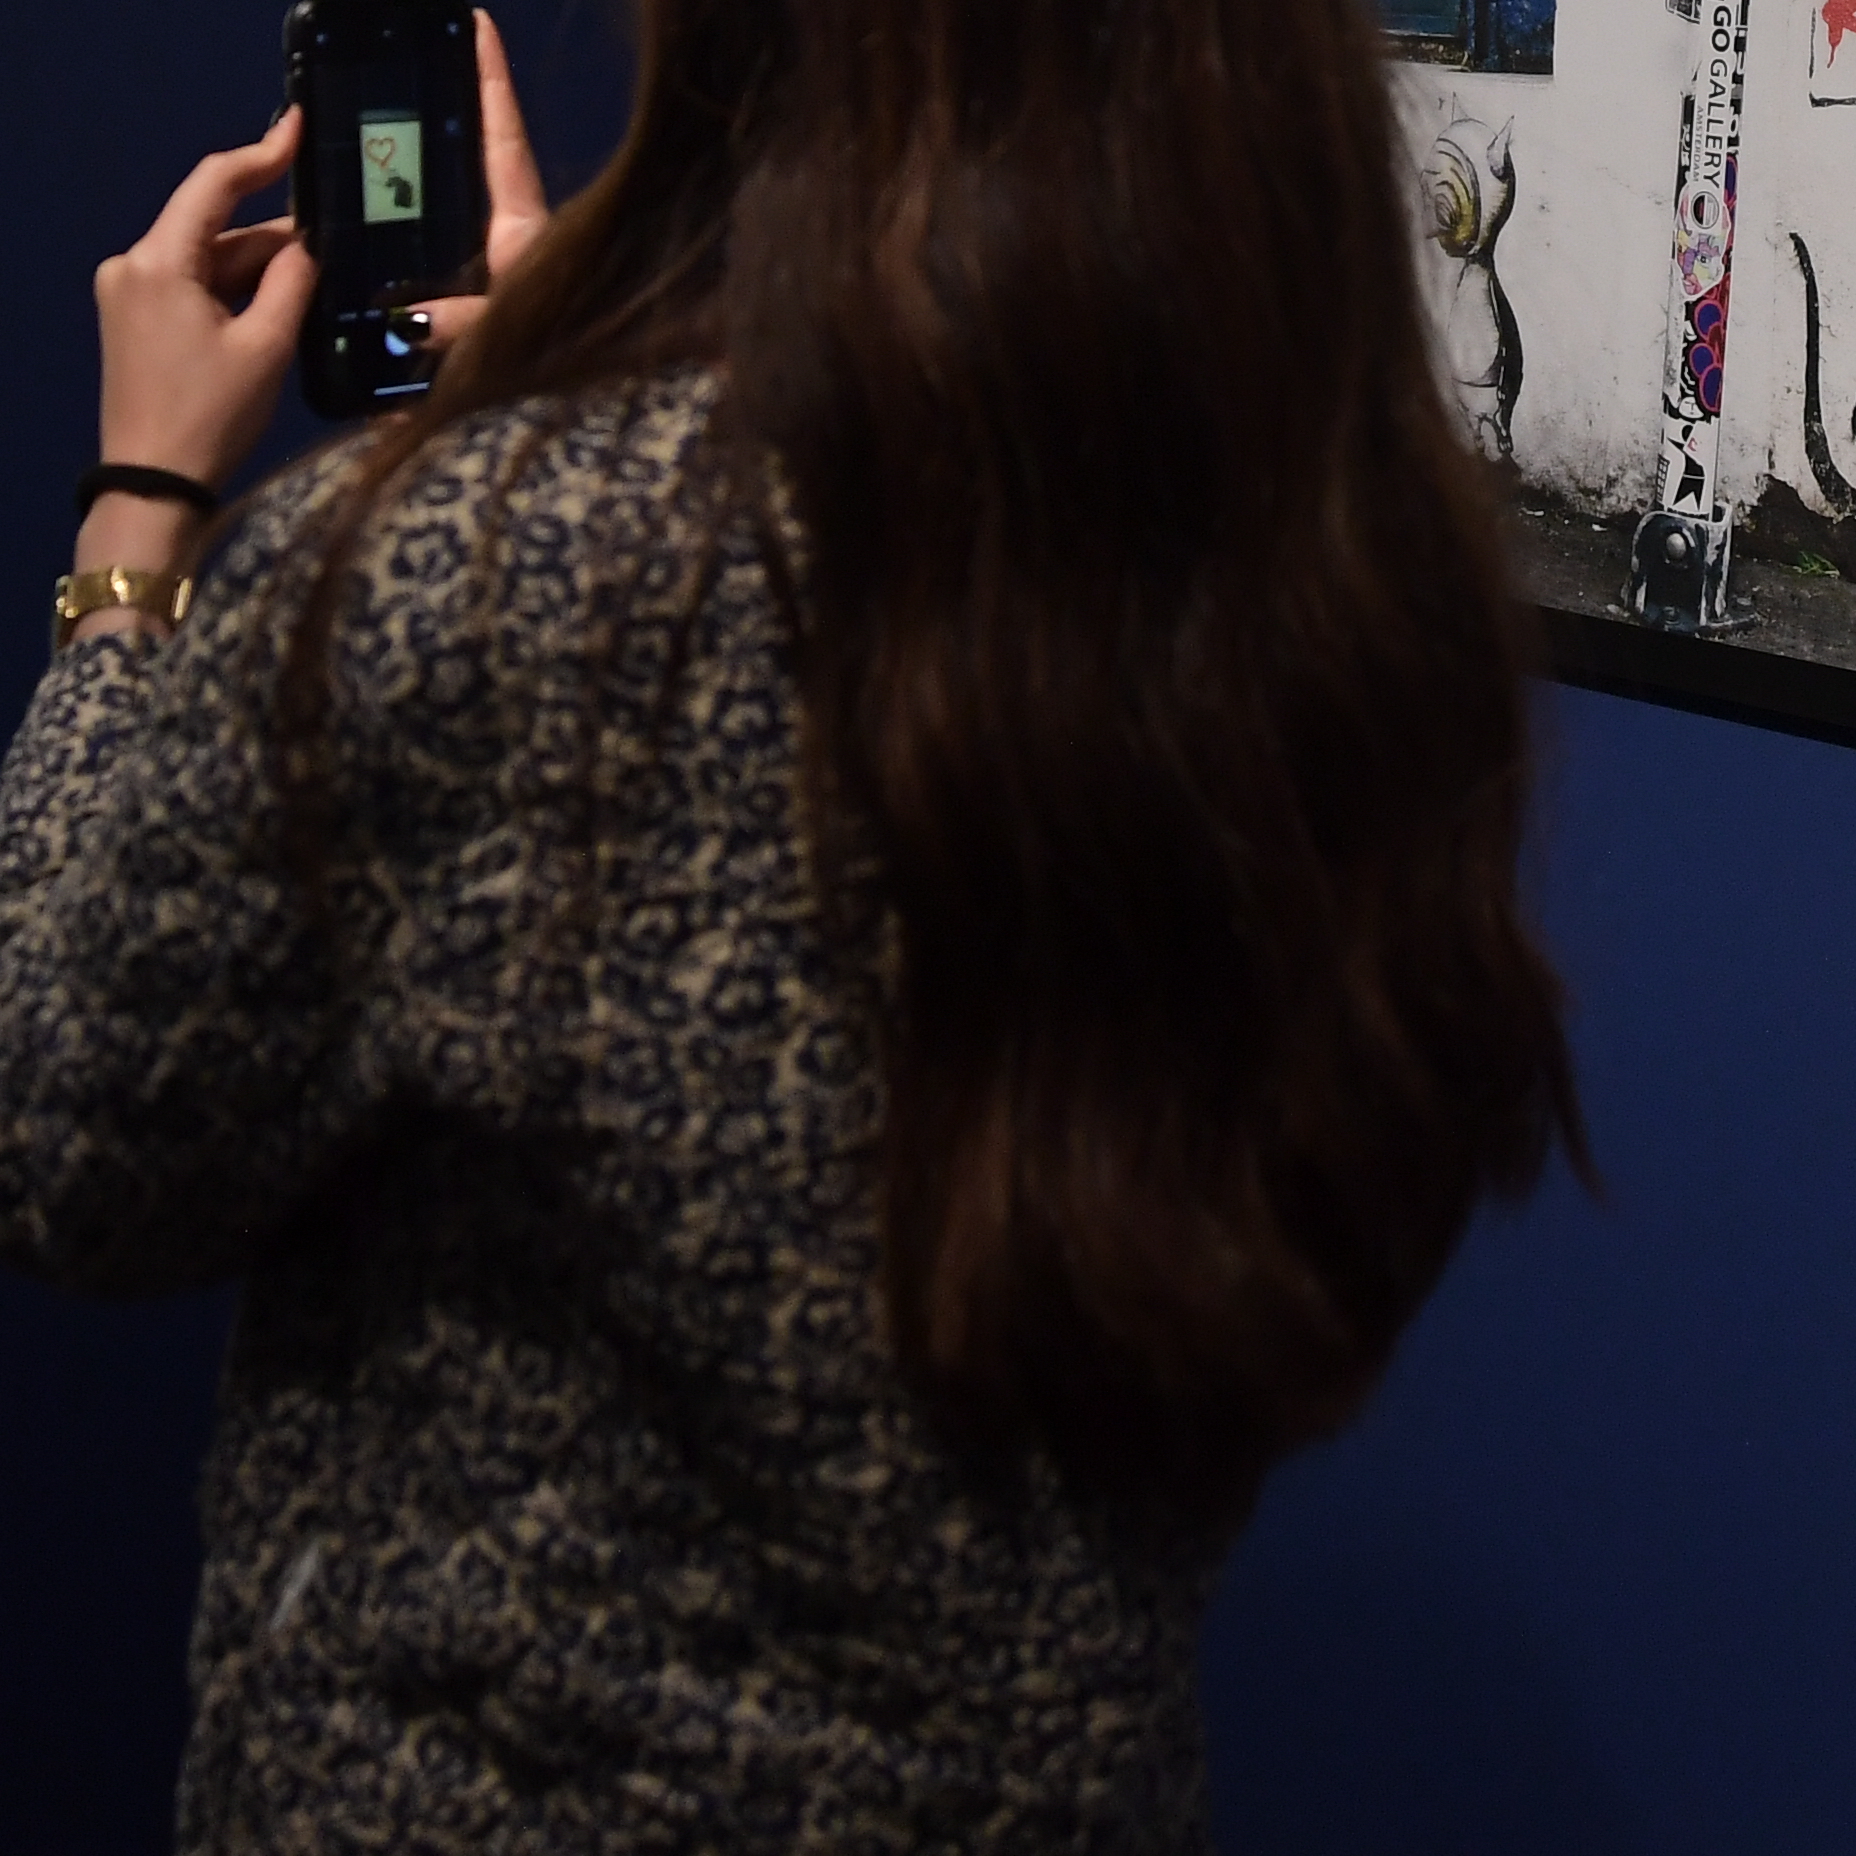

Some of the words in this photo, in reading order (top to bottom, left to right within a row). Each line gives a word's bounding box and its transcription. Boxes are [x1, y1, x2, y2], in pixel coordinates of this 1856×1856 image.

[1710, 5, 1732, 53] GO
[1693, 104, 1705, 183] AMSTERDAM
[1703, 58, 1729, 190] GALLERY
